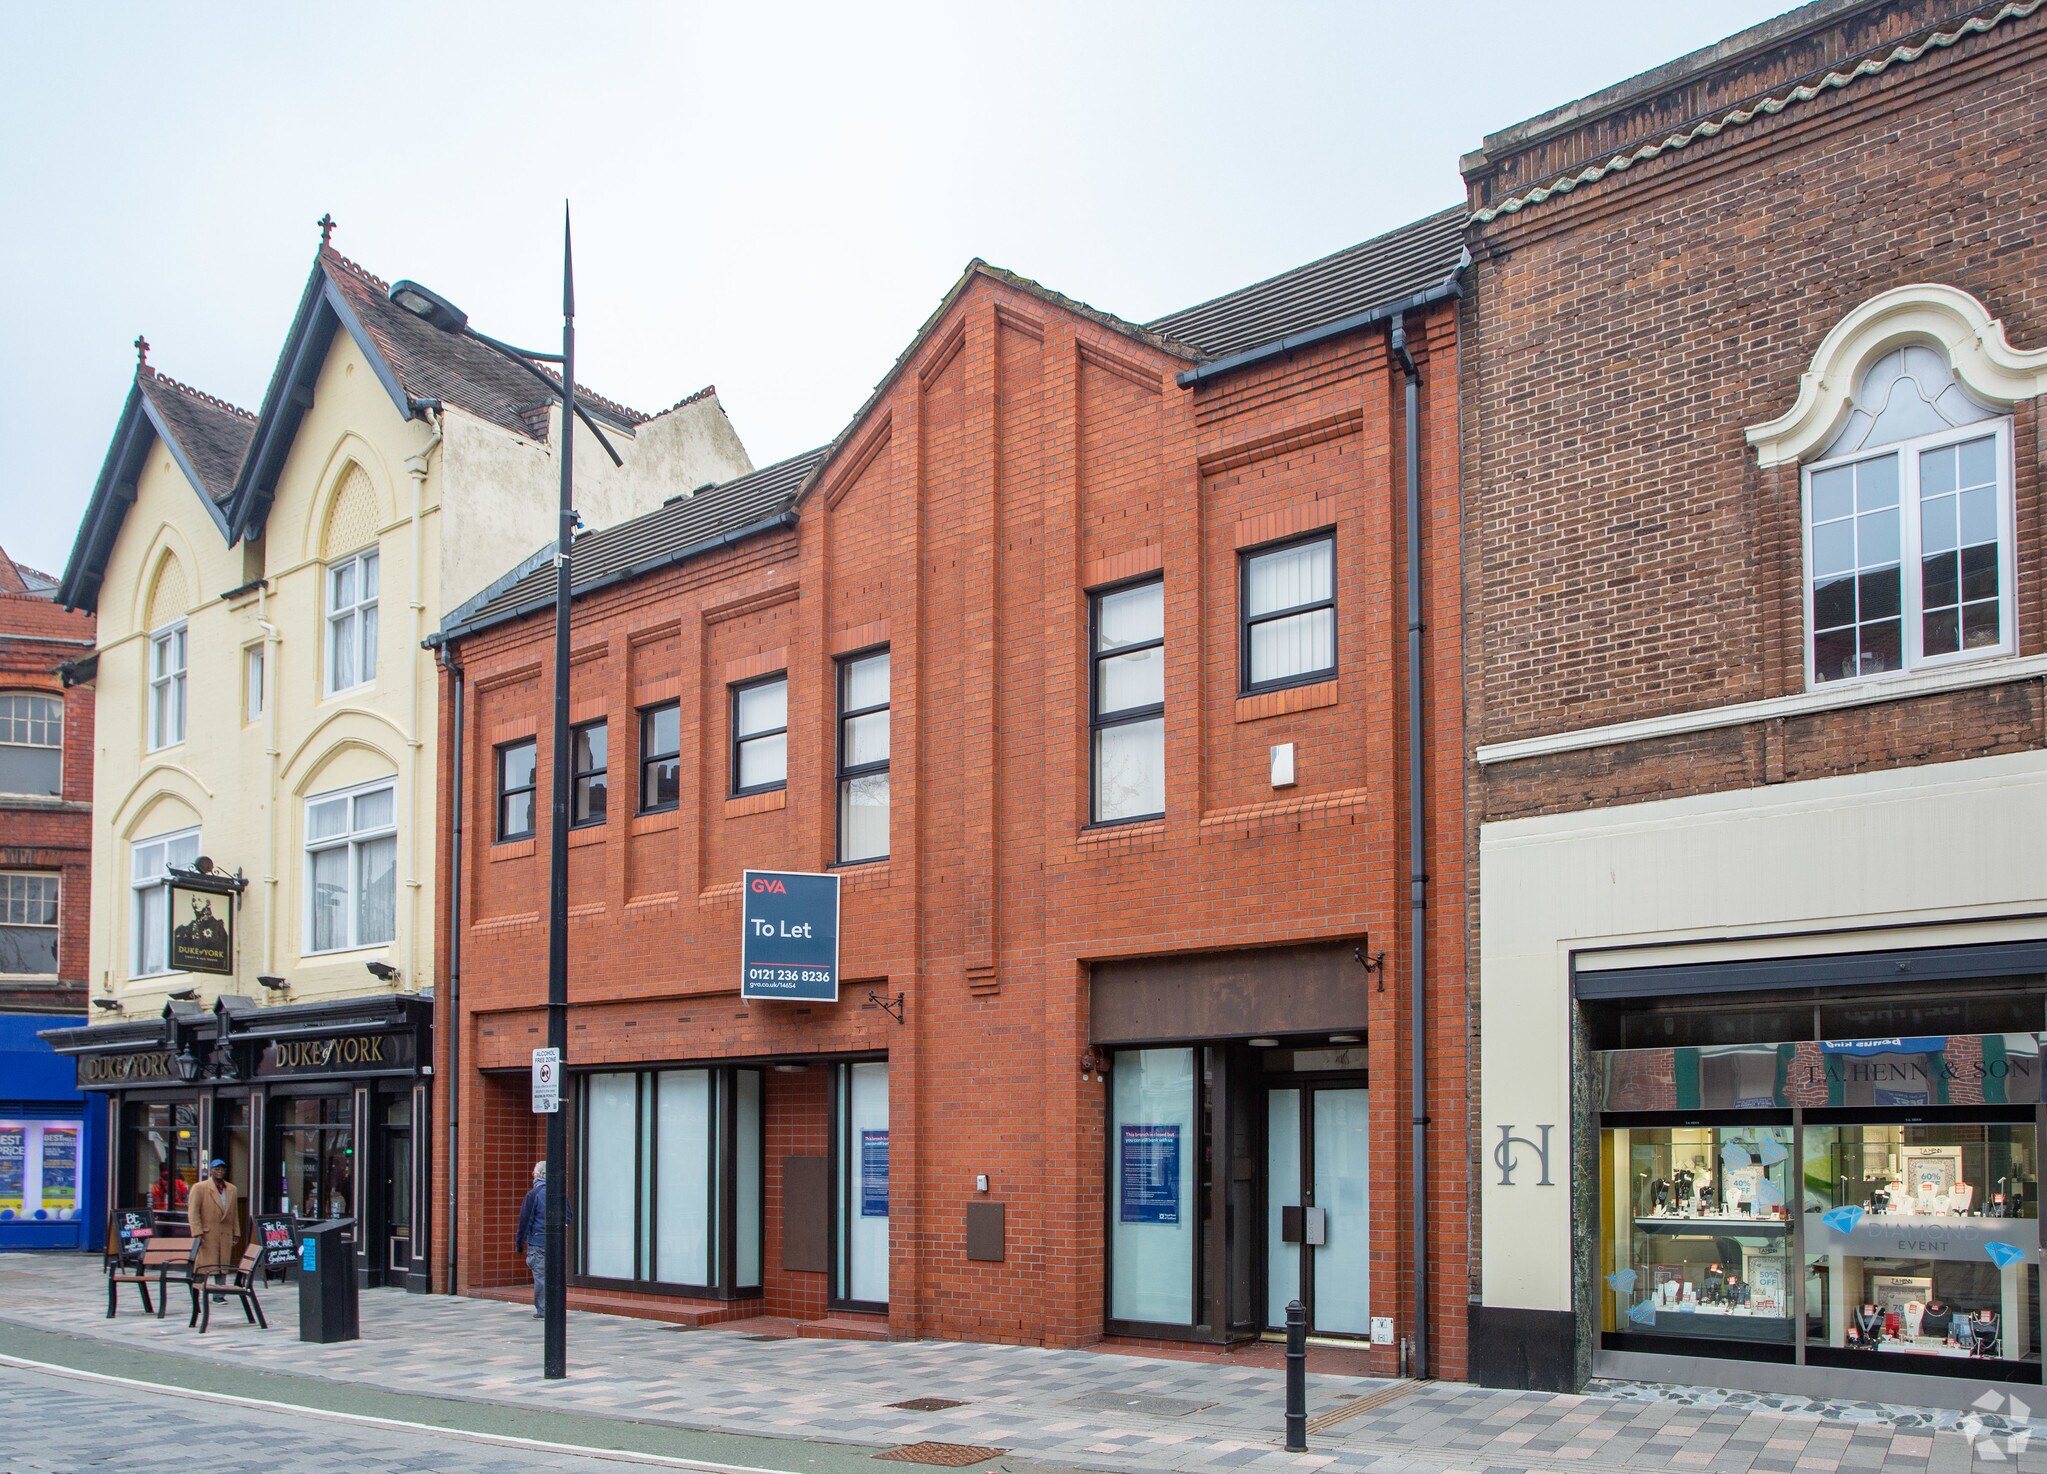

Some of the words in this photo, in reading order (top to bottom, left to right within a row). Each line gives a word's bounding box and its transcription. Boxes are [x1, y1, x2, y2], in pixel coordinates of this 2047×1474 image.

[751, 878, 787, 894] GVA
[751, 918, 775, 937] To
[780, 920, 812, 939] Let
[178, 946, 199, 955] DUKE
[204, 949, 224, 958] YORK
[750, 969, 774, 980] 0121
[777, 970, 798, 981] 236
[801, 971, 830, 983] 8236
[276, 1041, 321, 1067] DUKE
[321, 1039, 336, 1066] of
[333, 1036, 383, 1063] YORK
[88, 1056, 122, 1079] DUKE
[131, 1053, 171, 1076] YORK
[1853, 1062, 1929, 1082] HENN
[1940, 1061, 1960, 1080] &
[1973, 1059, 2031, 1079] SON
[0, 1135, 21, 1145] EST
[44, 1134, 63, 1142] BEST
[1920, 1172, 1941, 1181] 60%
[1868, 1222, 1981, 1241] DIAMOND
[1898, 1240, 1949, 1252] EVENT
[1892, 1304, 1904, 1312] 70
